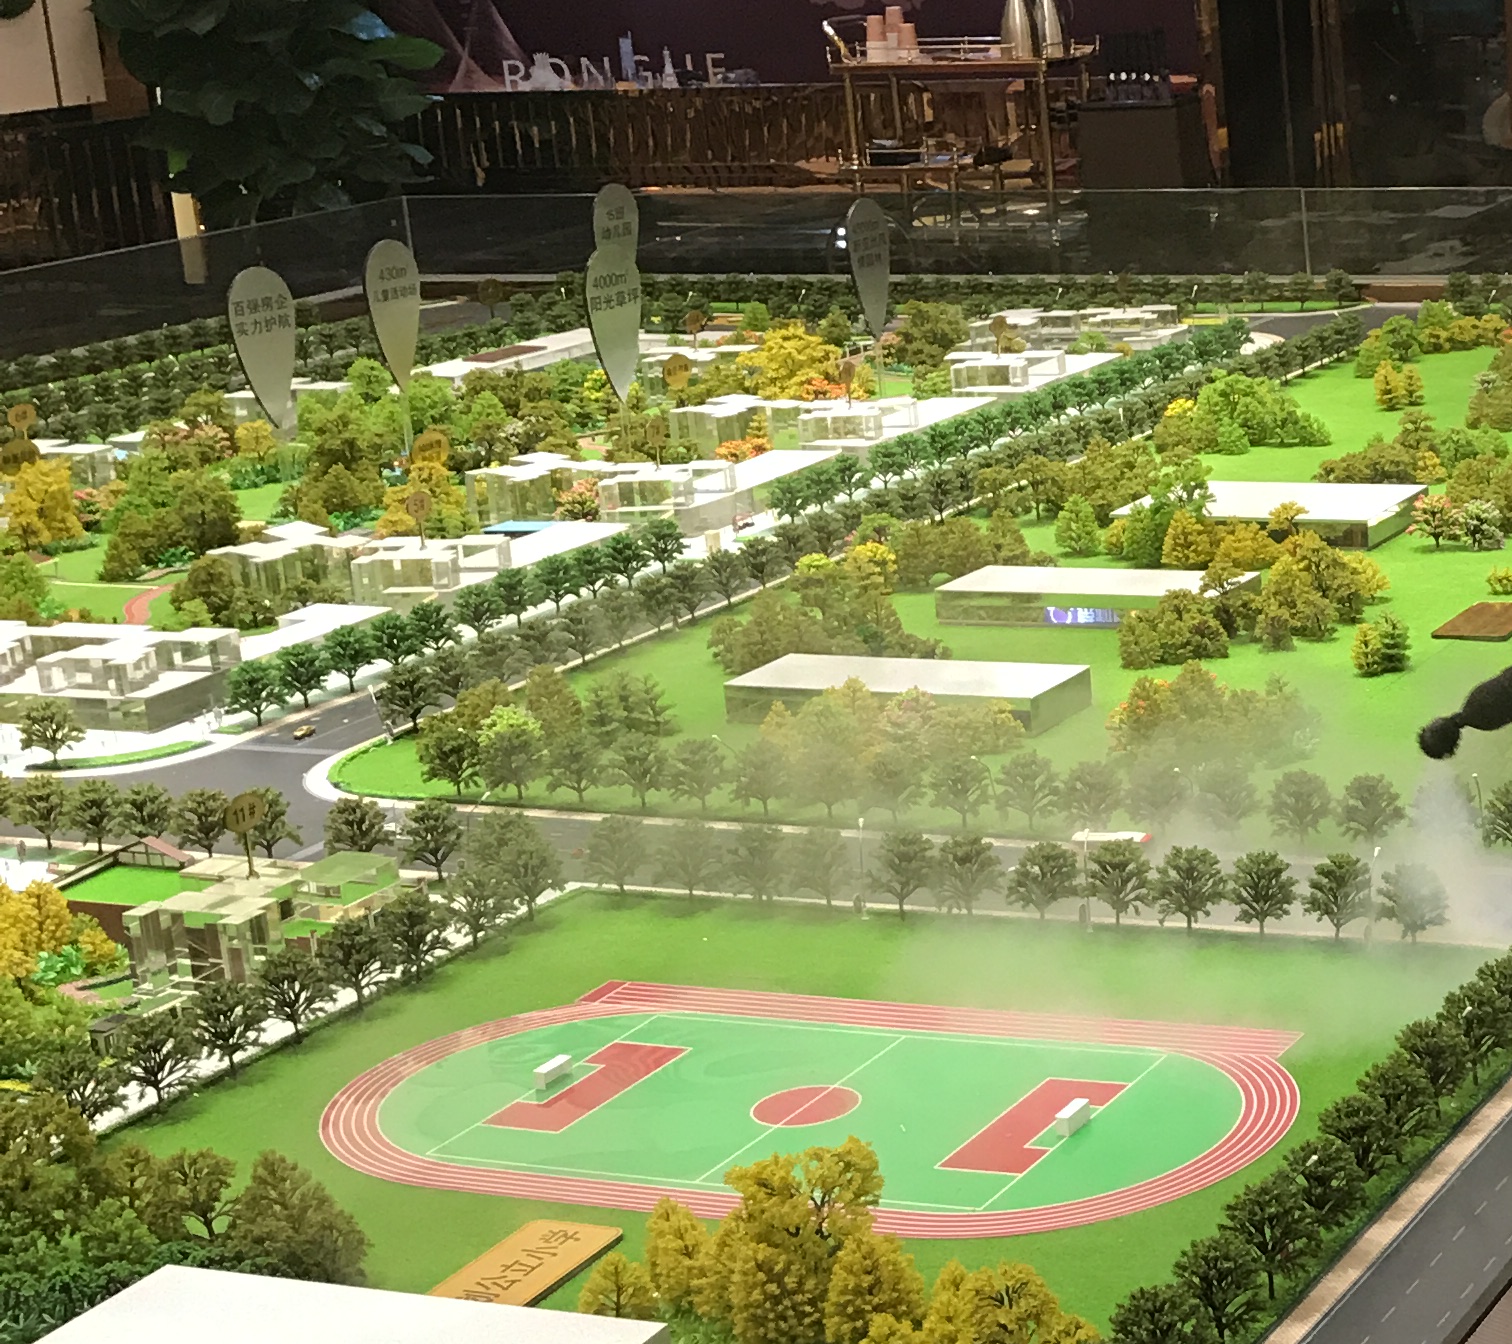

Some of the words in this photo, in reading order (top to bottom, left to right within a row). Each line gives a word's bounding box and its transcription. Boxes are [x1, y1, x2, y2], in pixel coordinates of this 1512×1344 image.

[232, 293, 289, 318] 百强房企
[235, 314, 292, 337] 实力护航
